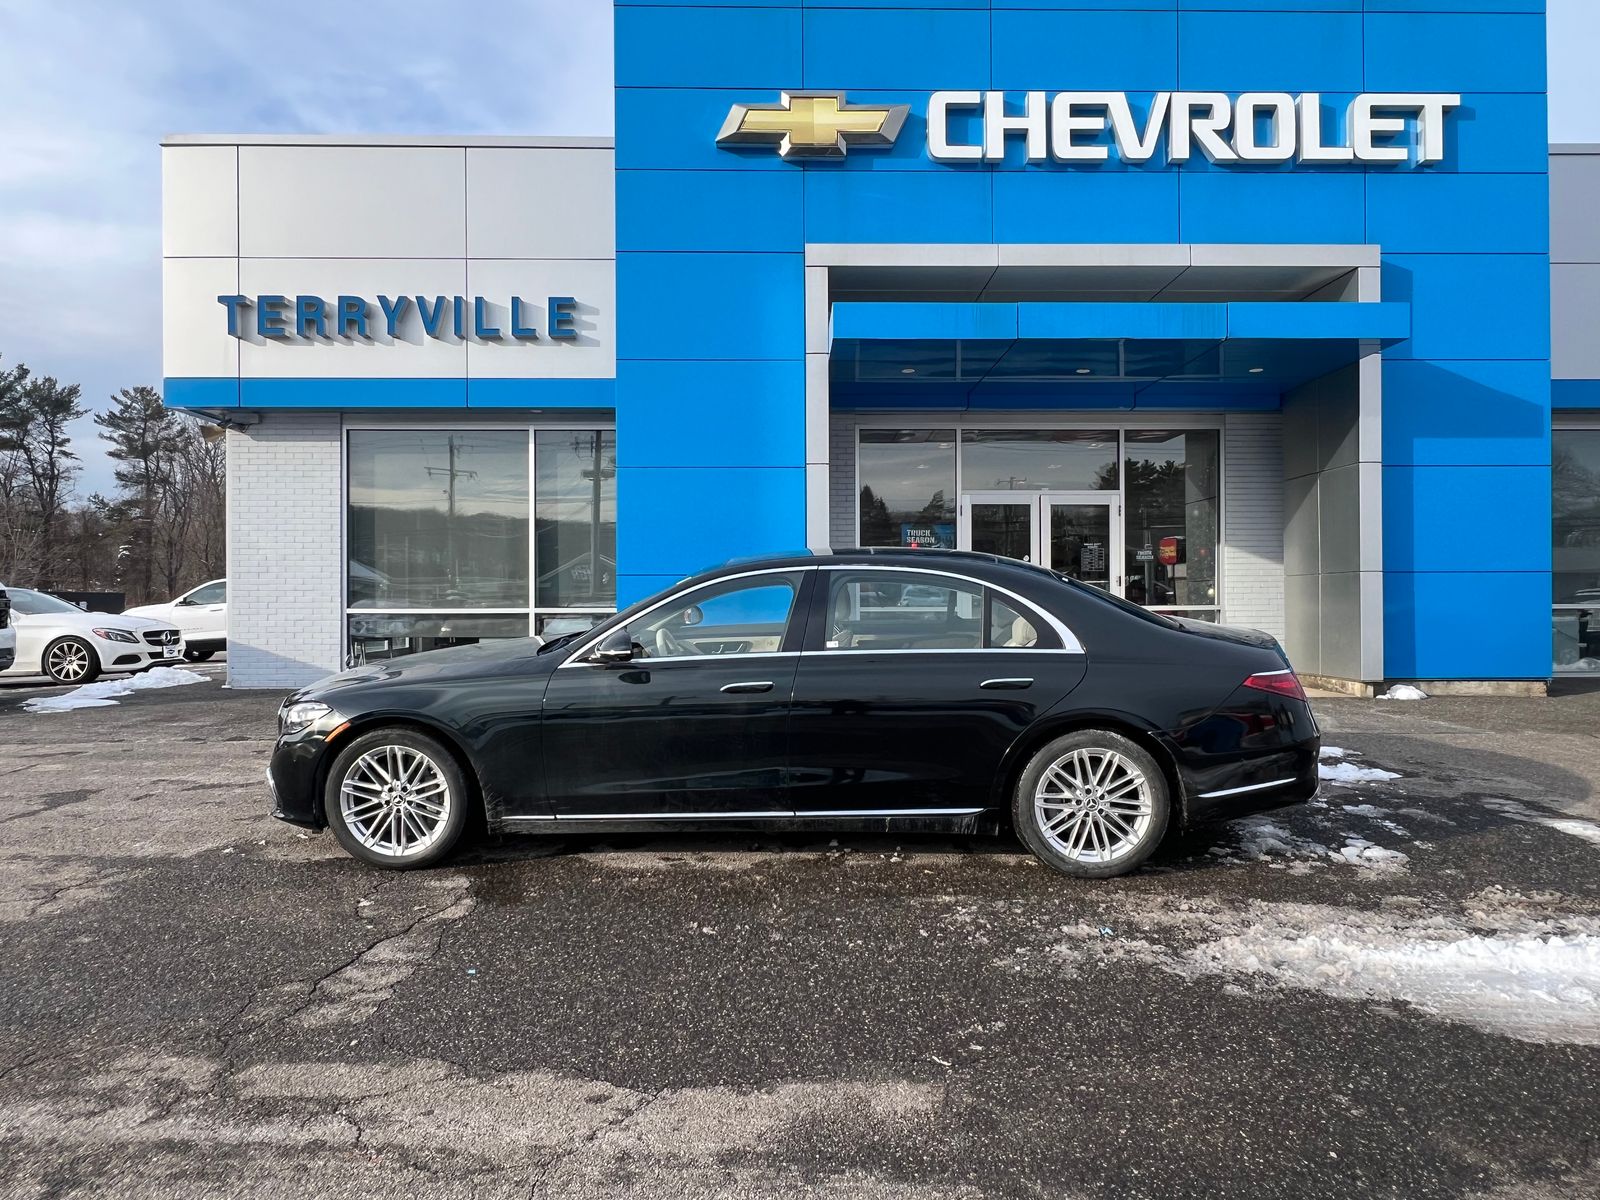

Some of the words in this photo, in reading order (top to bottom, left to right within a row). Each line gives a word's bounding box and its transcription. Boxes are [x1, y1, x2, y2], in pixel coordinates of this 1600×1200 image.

[927, 90, 1461, 163] CHEVROLET
[217, 295, 577, 339] TERRYVILLE
[906, 529, 931, 537] TRUCK
[906, 536, 935, 544] SEASON
